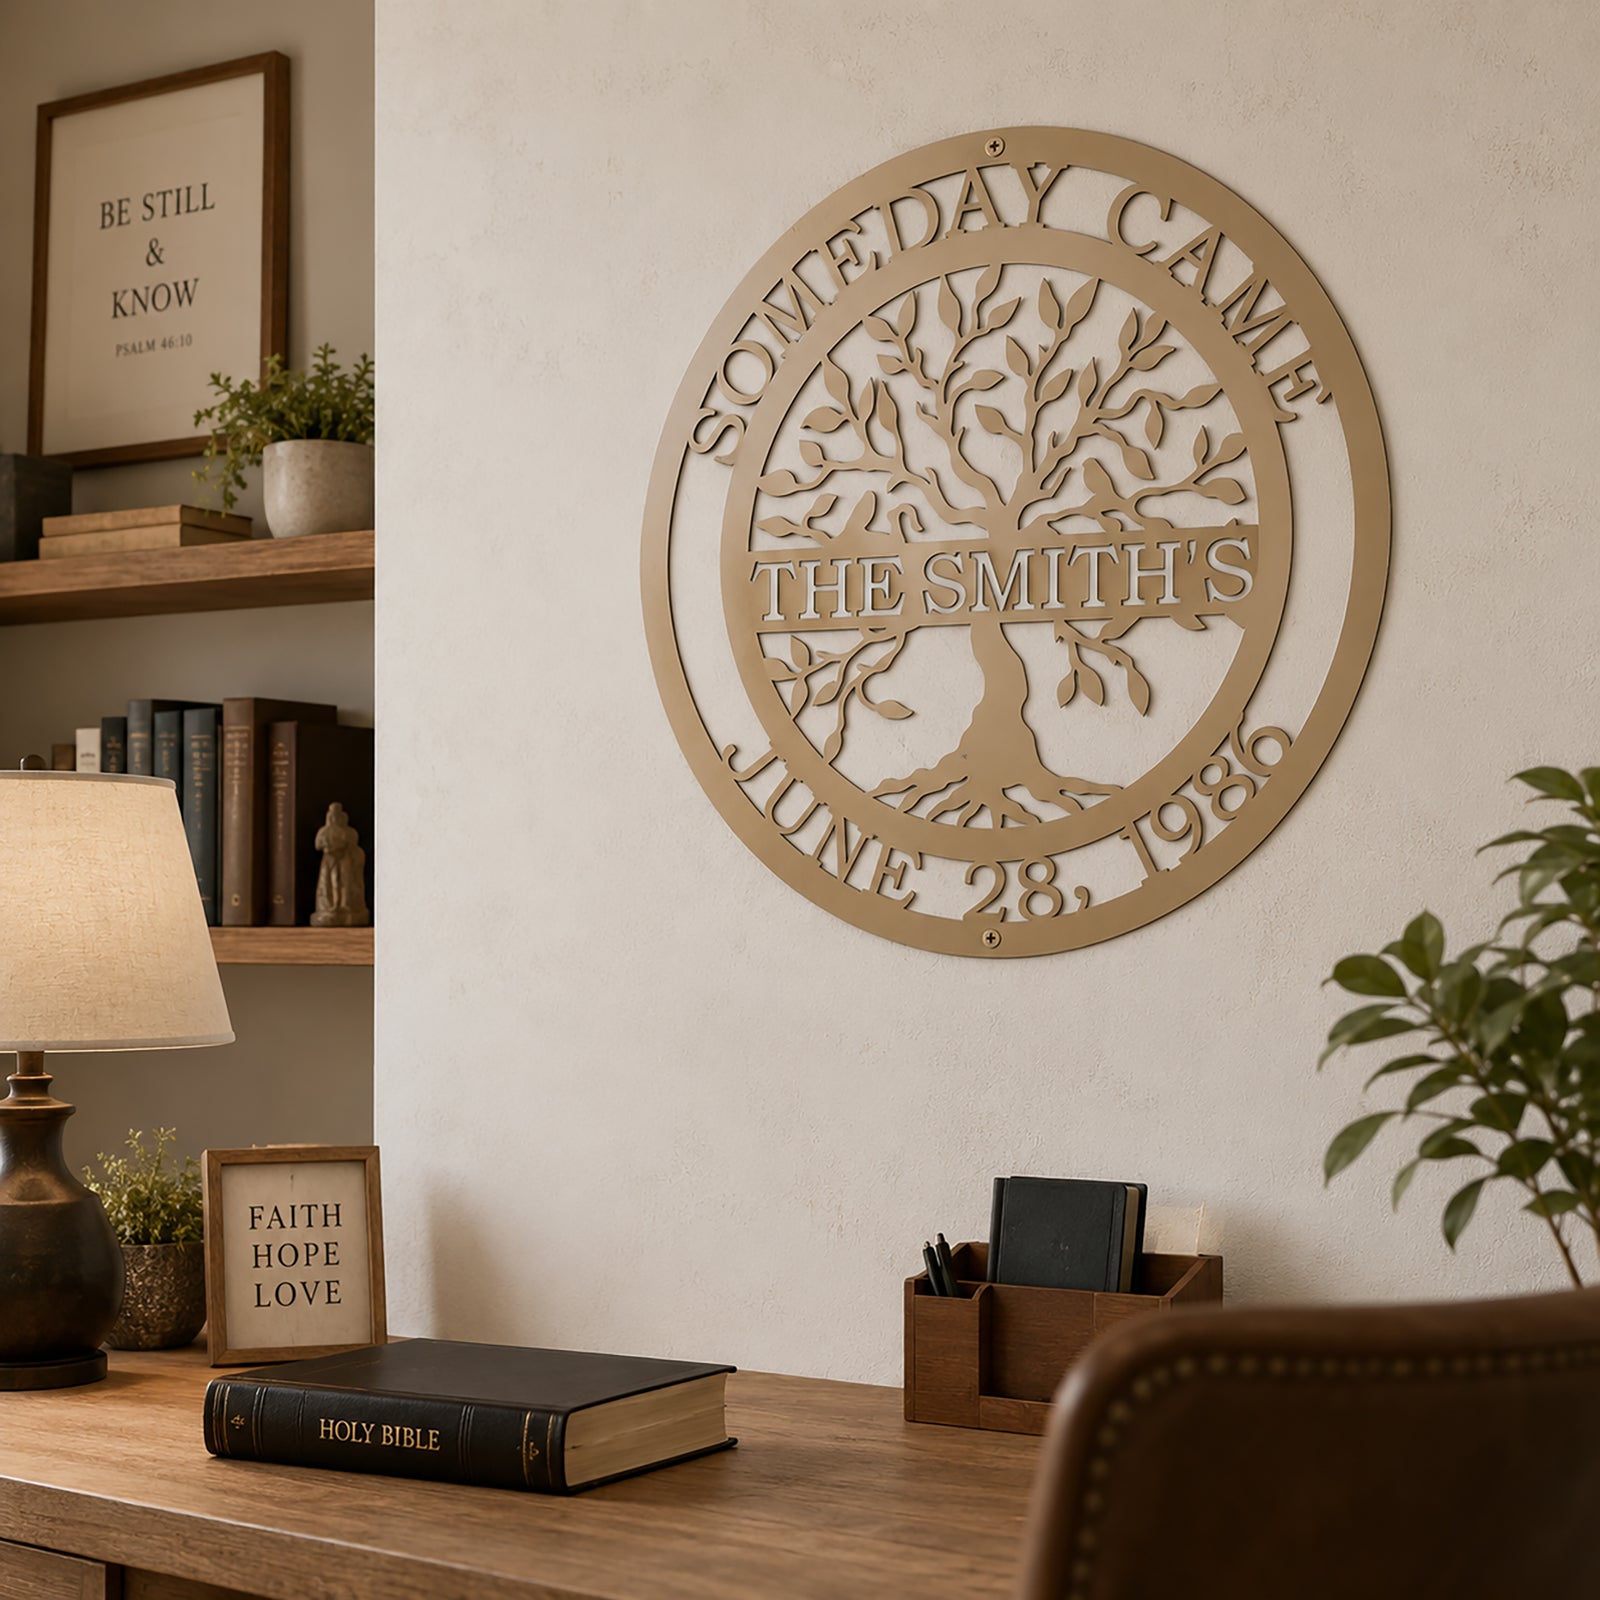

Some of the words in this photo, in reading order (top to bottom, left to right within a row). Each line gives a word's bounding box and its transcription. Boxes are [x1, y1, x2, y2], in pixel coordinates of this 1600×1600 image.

[99, 197, 131, 230] BE
[142, 183, 216, 222] STILL
[145, 237, 165, 267] &
[111, 278, 200, 319] KNOW
[688, 162, 1070, 466] SOMEDAY
[1106, 183, 1333, 424] CAME
[115, 339, 156, 357] PSALM
[161, 333, 193, 350] 46:10
[750, 554, 905, 622] THE
[922, 536, 1254, 613] SMITH'S
[721, 740, 923, 911] JUNE
[964, 855, 1092, 922] 28,
[1119, 710, 1294, 888] 1986
[249, 1203, 342, 1230] FAITH
[252, 1241, 340, 1269] HOPE
[254, 1279, 342, 1308] LOVE
[318, 1418, 375, 1445] HOLY
[381, 1424, 441, 1452] BIBLE
